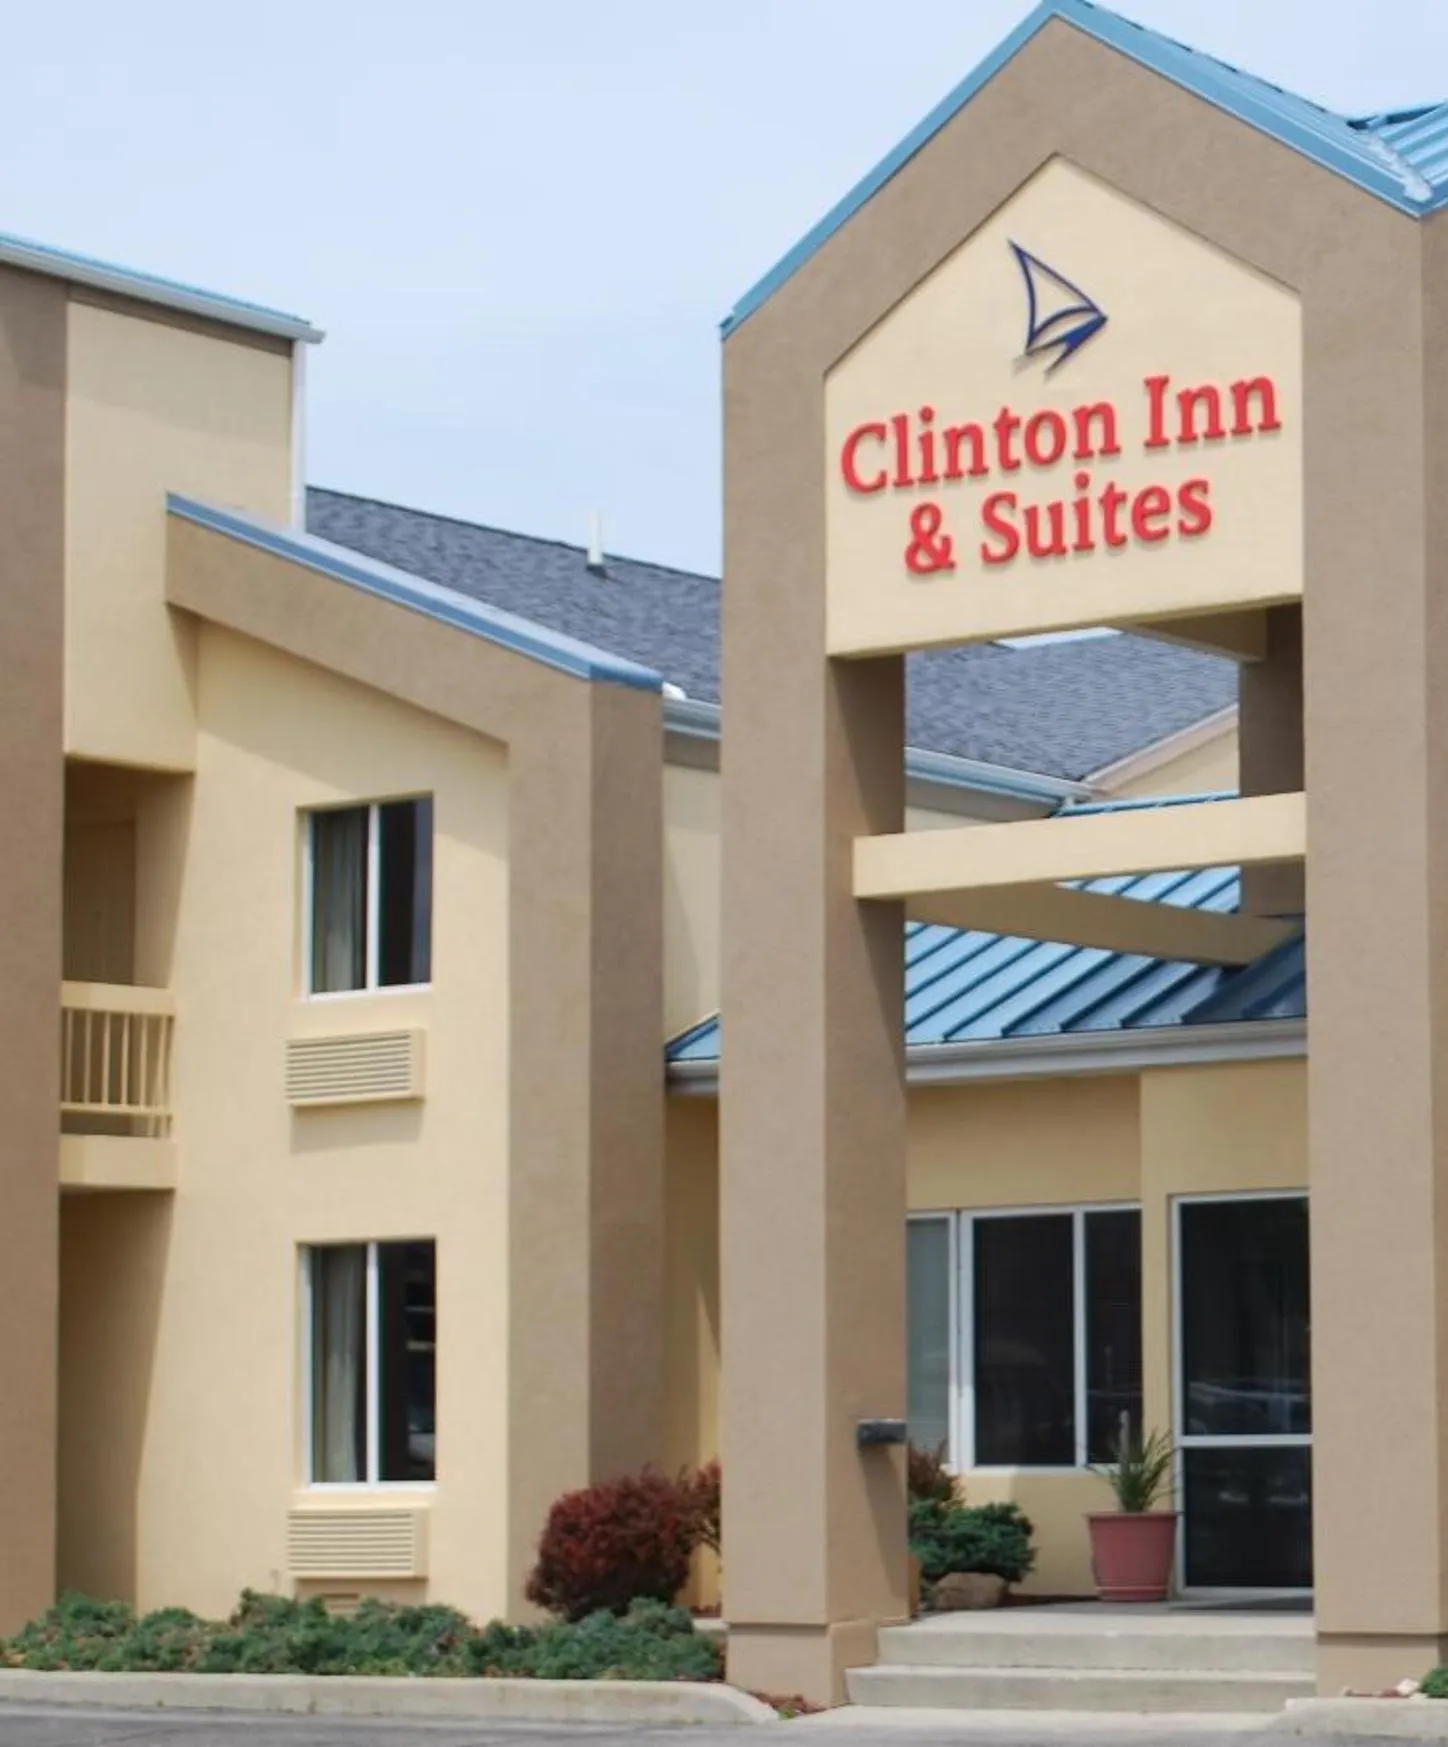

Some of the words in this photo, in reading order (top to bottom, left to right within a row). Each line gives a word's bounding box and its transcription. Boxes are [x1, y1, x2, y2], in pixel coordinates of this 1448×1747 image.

[840, 401, 1121, 495] Clinton
[1143, 374, 1282, 449] Inn
[904, 501, 957, 575] &
[980, 471, 1215, 565] Suites
